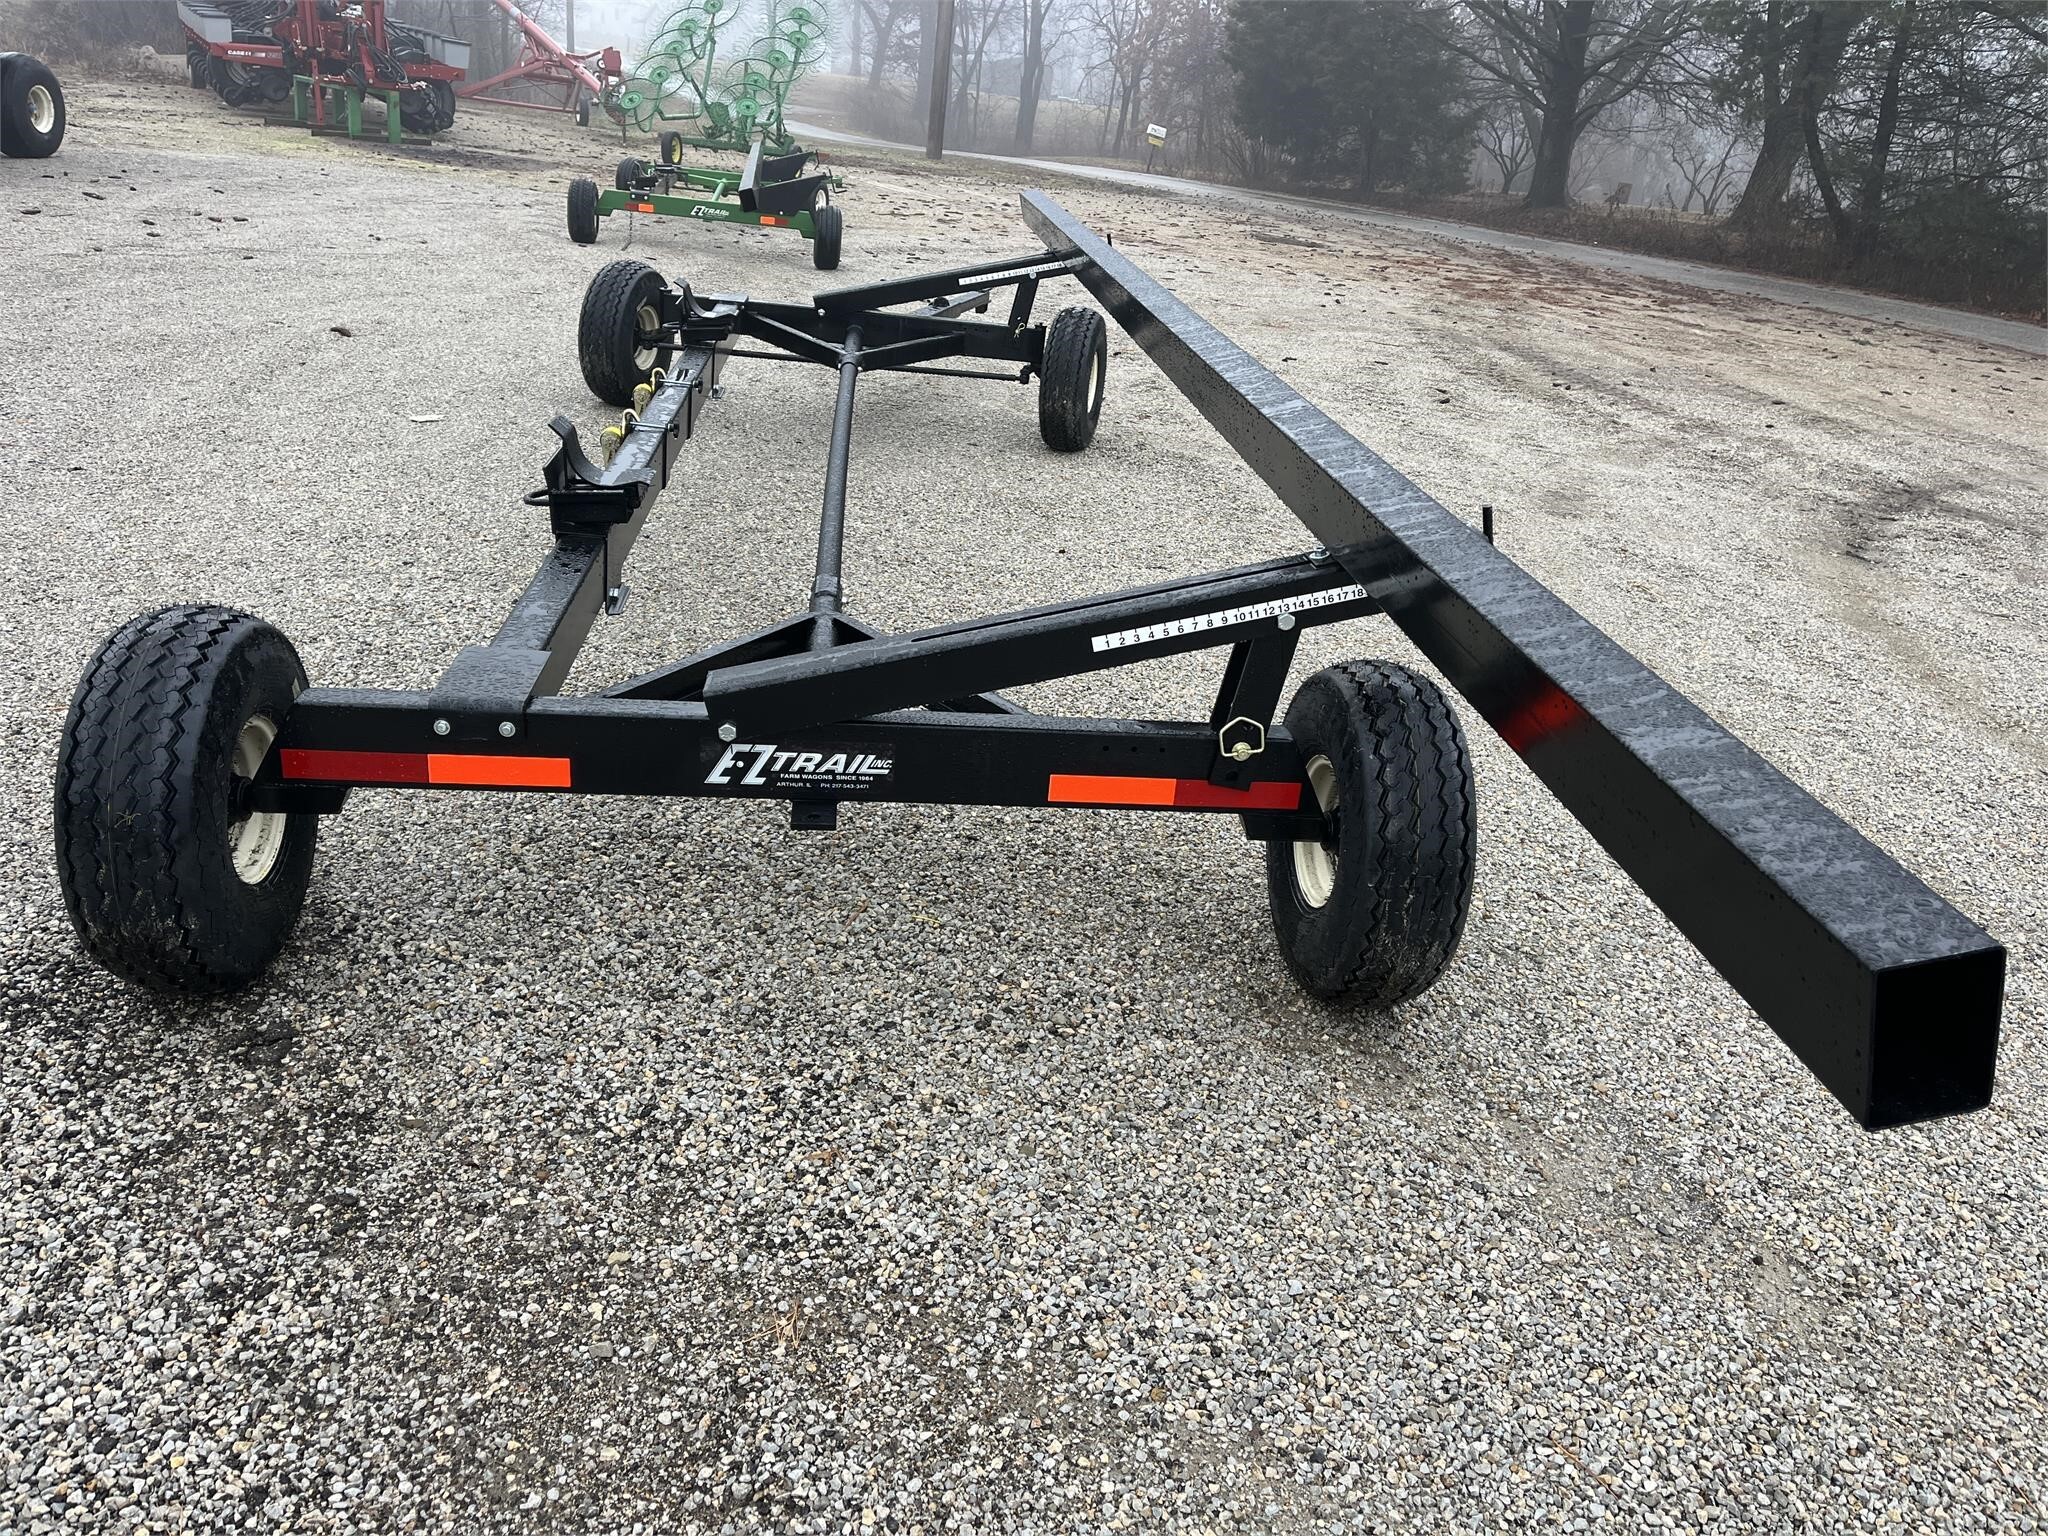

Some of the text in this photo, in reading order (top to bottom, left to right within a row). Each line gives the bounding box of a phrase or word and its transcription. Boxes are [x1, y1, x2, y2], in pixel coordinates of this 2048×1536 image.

[1105, 588, 1364, 648] 1 2 3 4 5 6 7 8 9 10 11 12 13 14 15 16 17 18
[770, 751, 891, 775] TRAIL
